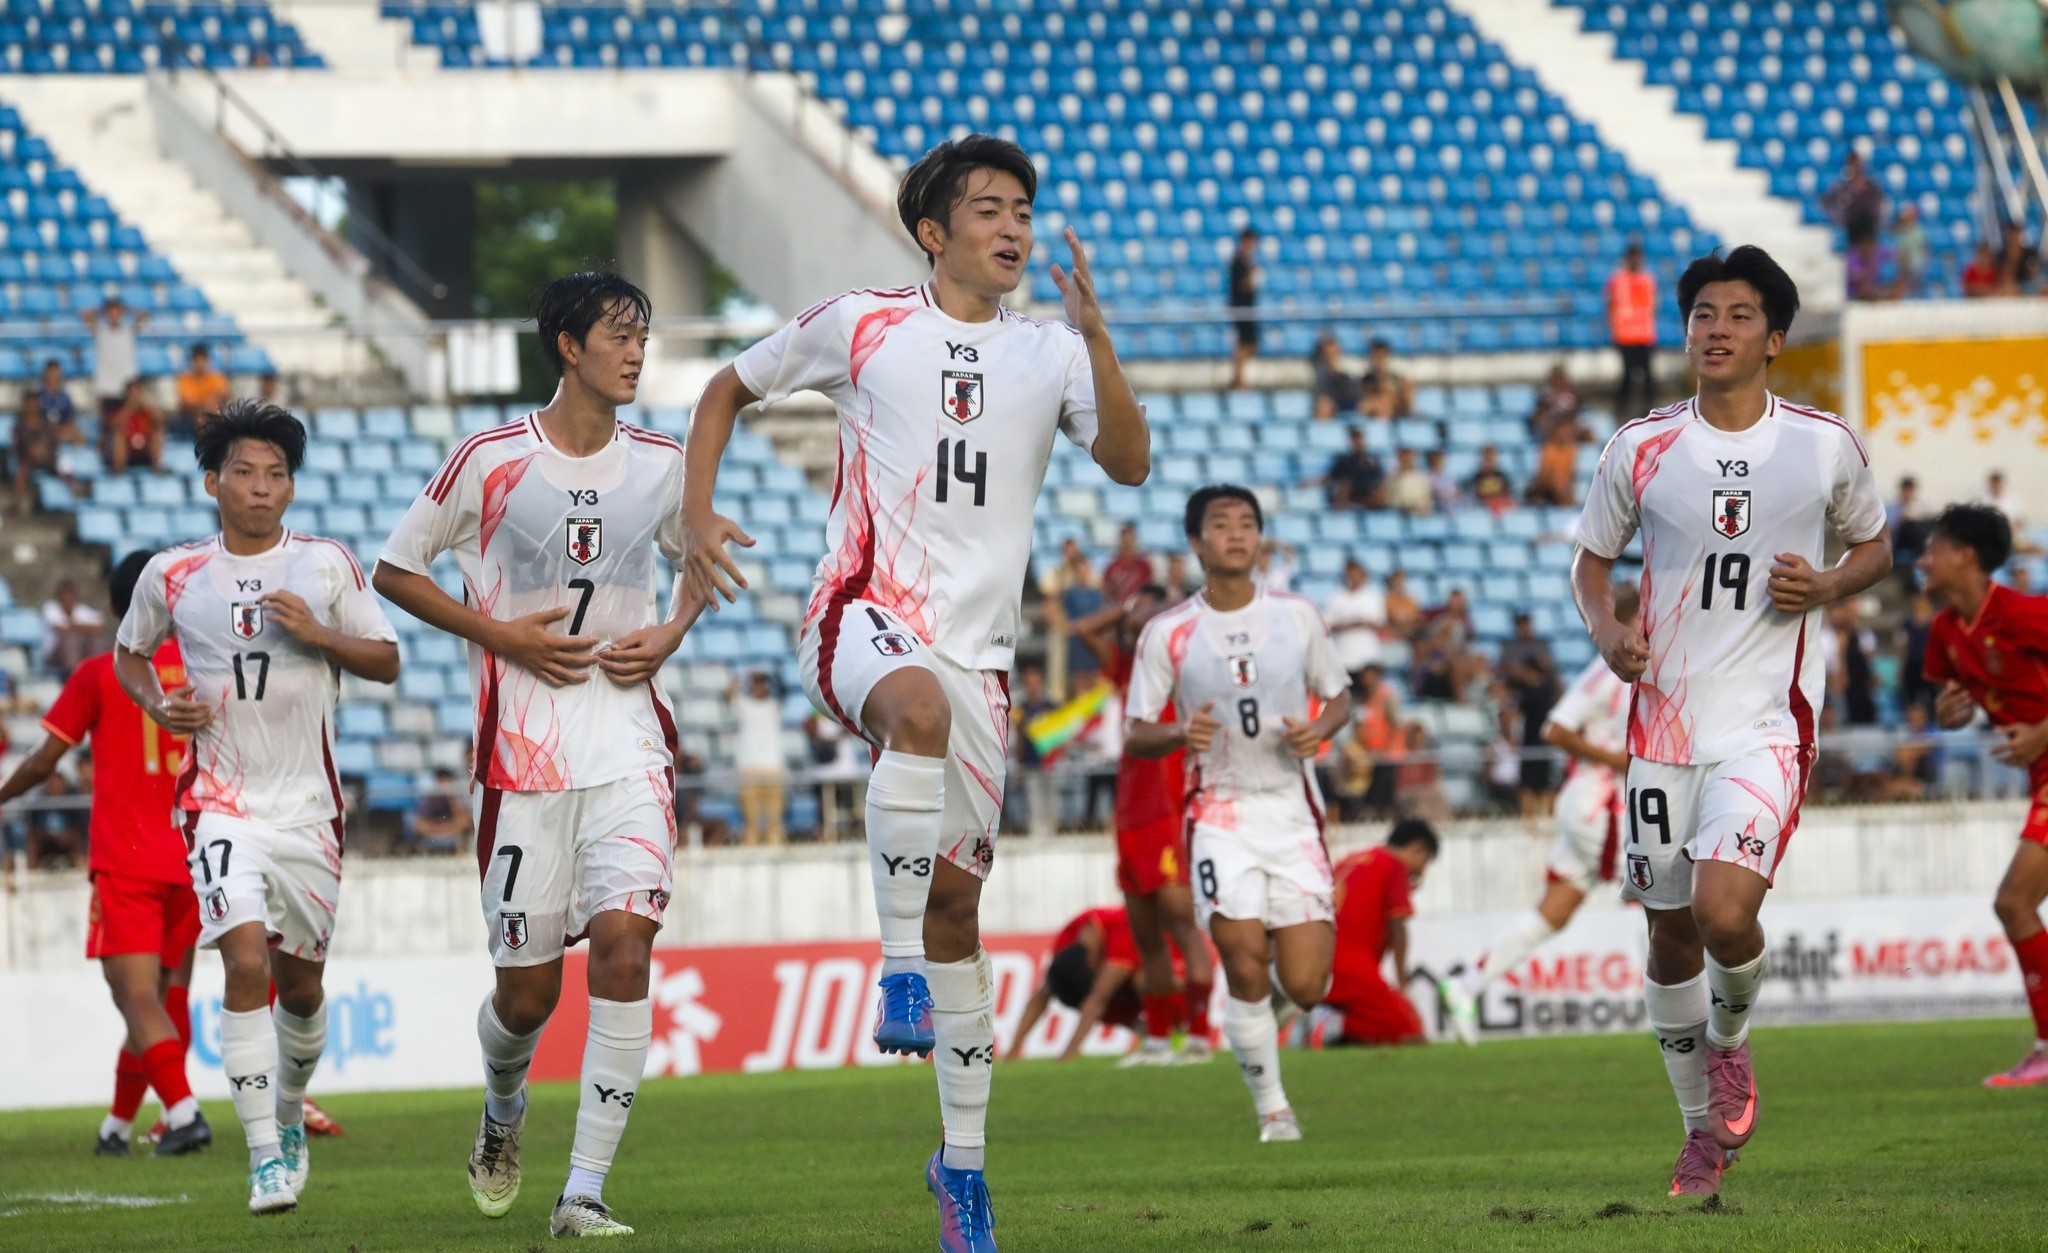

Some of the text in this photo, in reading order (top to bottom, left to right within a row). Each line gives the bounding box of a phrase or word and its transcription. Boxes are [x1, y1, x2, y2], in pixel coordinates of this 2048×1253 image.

[945, 341, 979, 362] Y-3
[951, 371, 975, 379] JAPAN
[936, 437, 987, 506] 14
[1716, 459, 1749, 477] Y-3
[568, 490, 599, 506] Y-3
[236, 579, 262, 592] Y-3
[1701, 552, 1751, 610] 19
[567, 578, 595, 636] 7
[233, 652, 271, 700] 17
[1238, 697, 1260, 739] 8
[1629, 787, 1671, 845] 19
[1735, 832, 1766, 857] Y-3
[199, 838, 233, 886] 17
[497, 844, 523, 902] 7
[881, 852, 931, 877] Y-3
[1198, 858, 1218, 898] 8
[951, 1044, 994, 1067] Y-3
[231, 1074, 269, 1091] Y-3
[593, 1083, 634, 1108] Y-3
